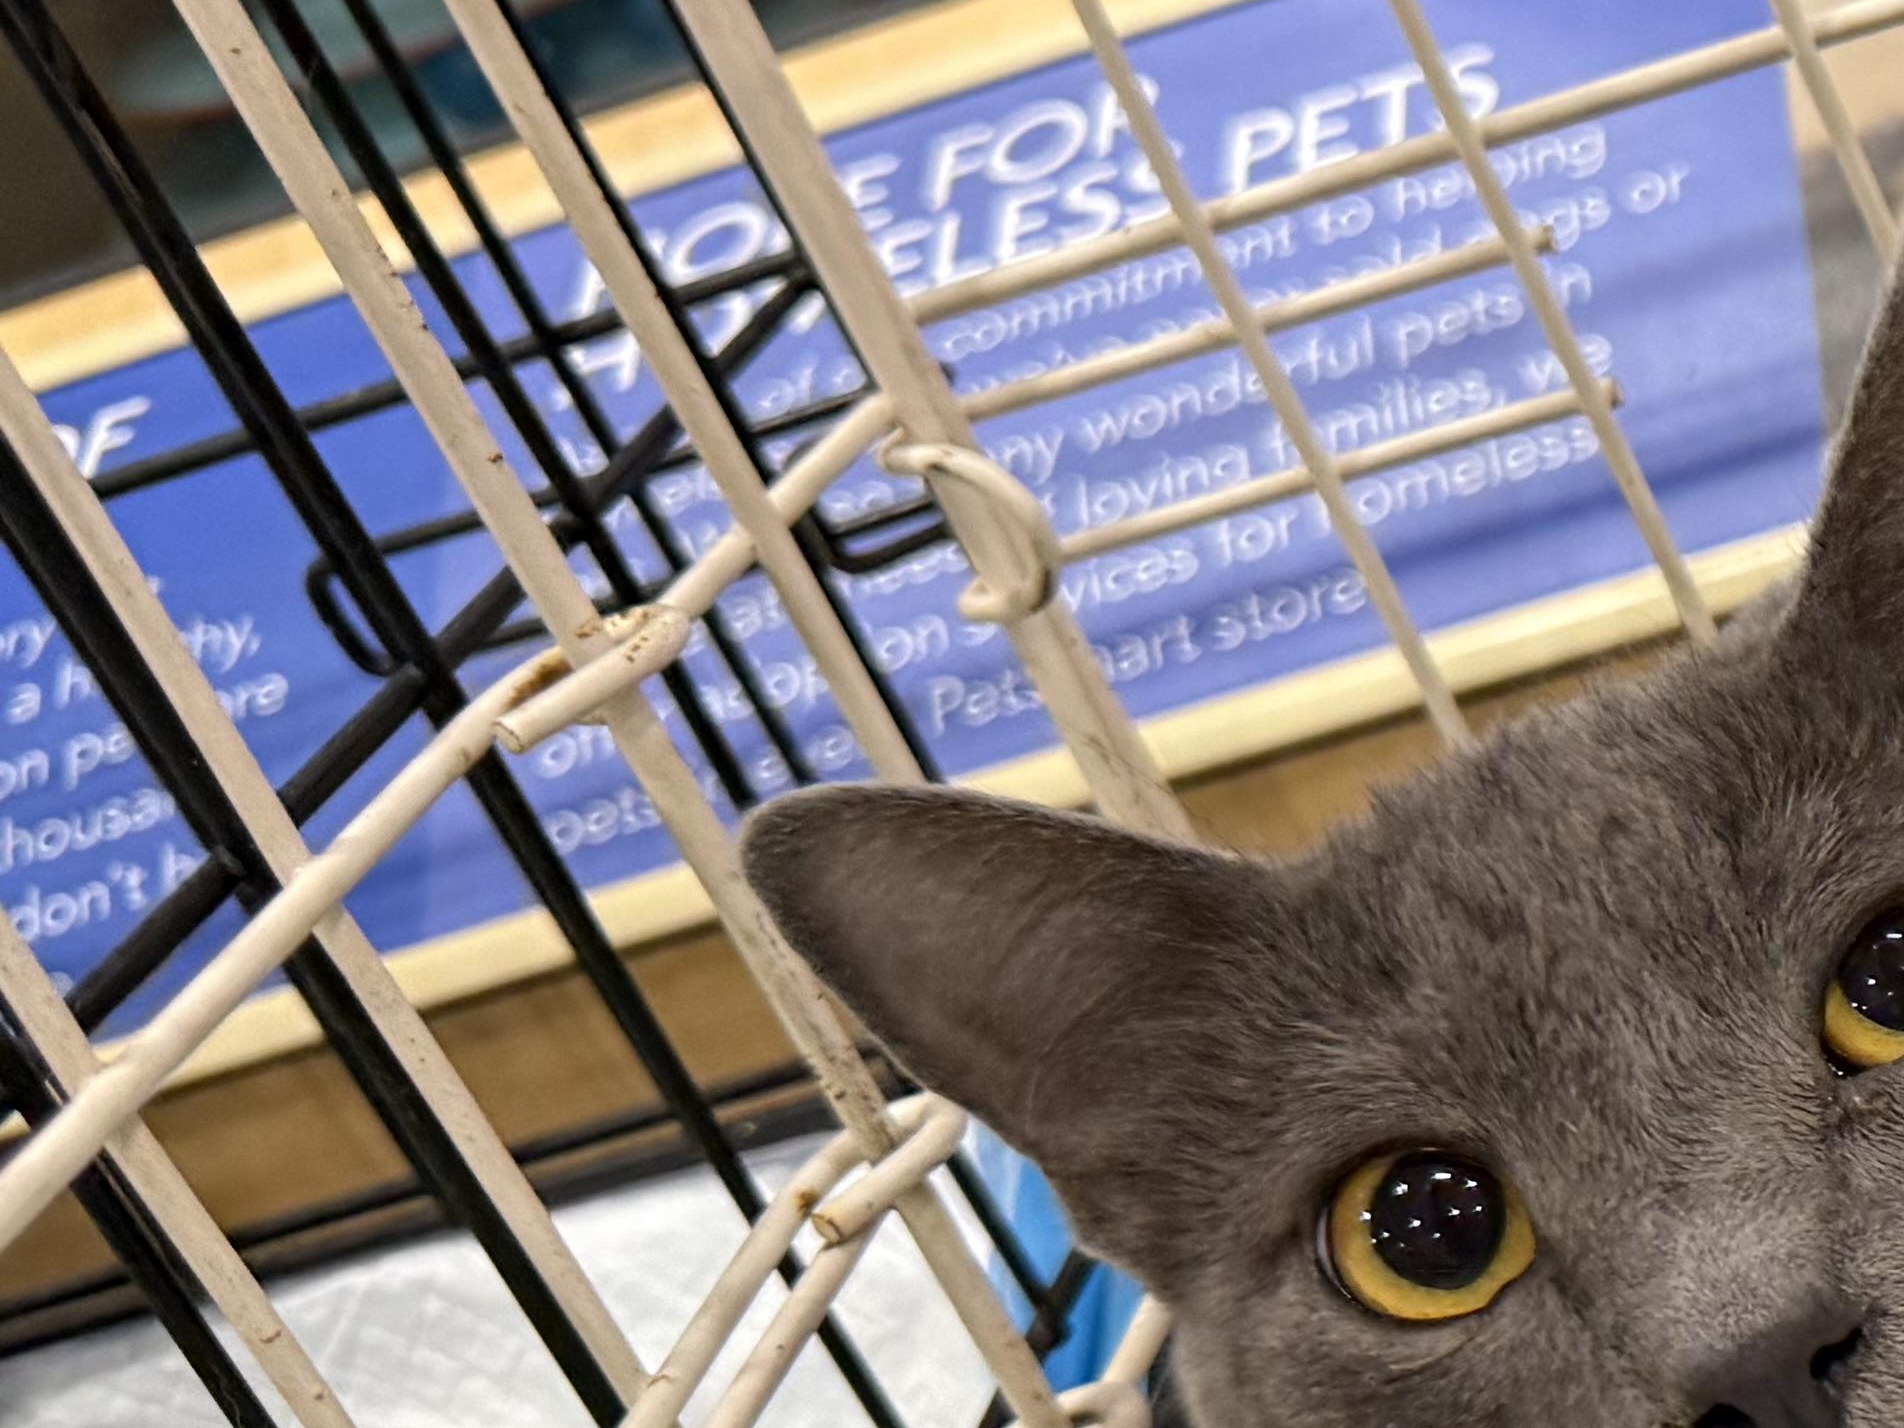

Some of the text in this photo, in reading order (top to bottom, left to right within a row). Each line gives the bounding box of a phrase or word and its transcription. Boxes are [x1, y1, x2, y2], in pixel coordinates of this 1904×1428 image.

[1222, 42, 1500, 194] PETS
[1309, 196, 1374, 245] to
[1385, 124, 1607, 223] heping
[1619, 162, 1691, 214] or
[1385, 282, 1525, 371] pets
[50, 395, 152, 480] F
[1259, 369, 1507, 470] fmilies,
[929, 614, 1203, 738] Petart
